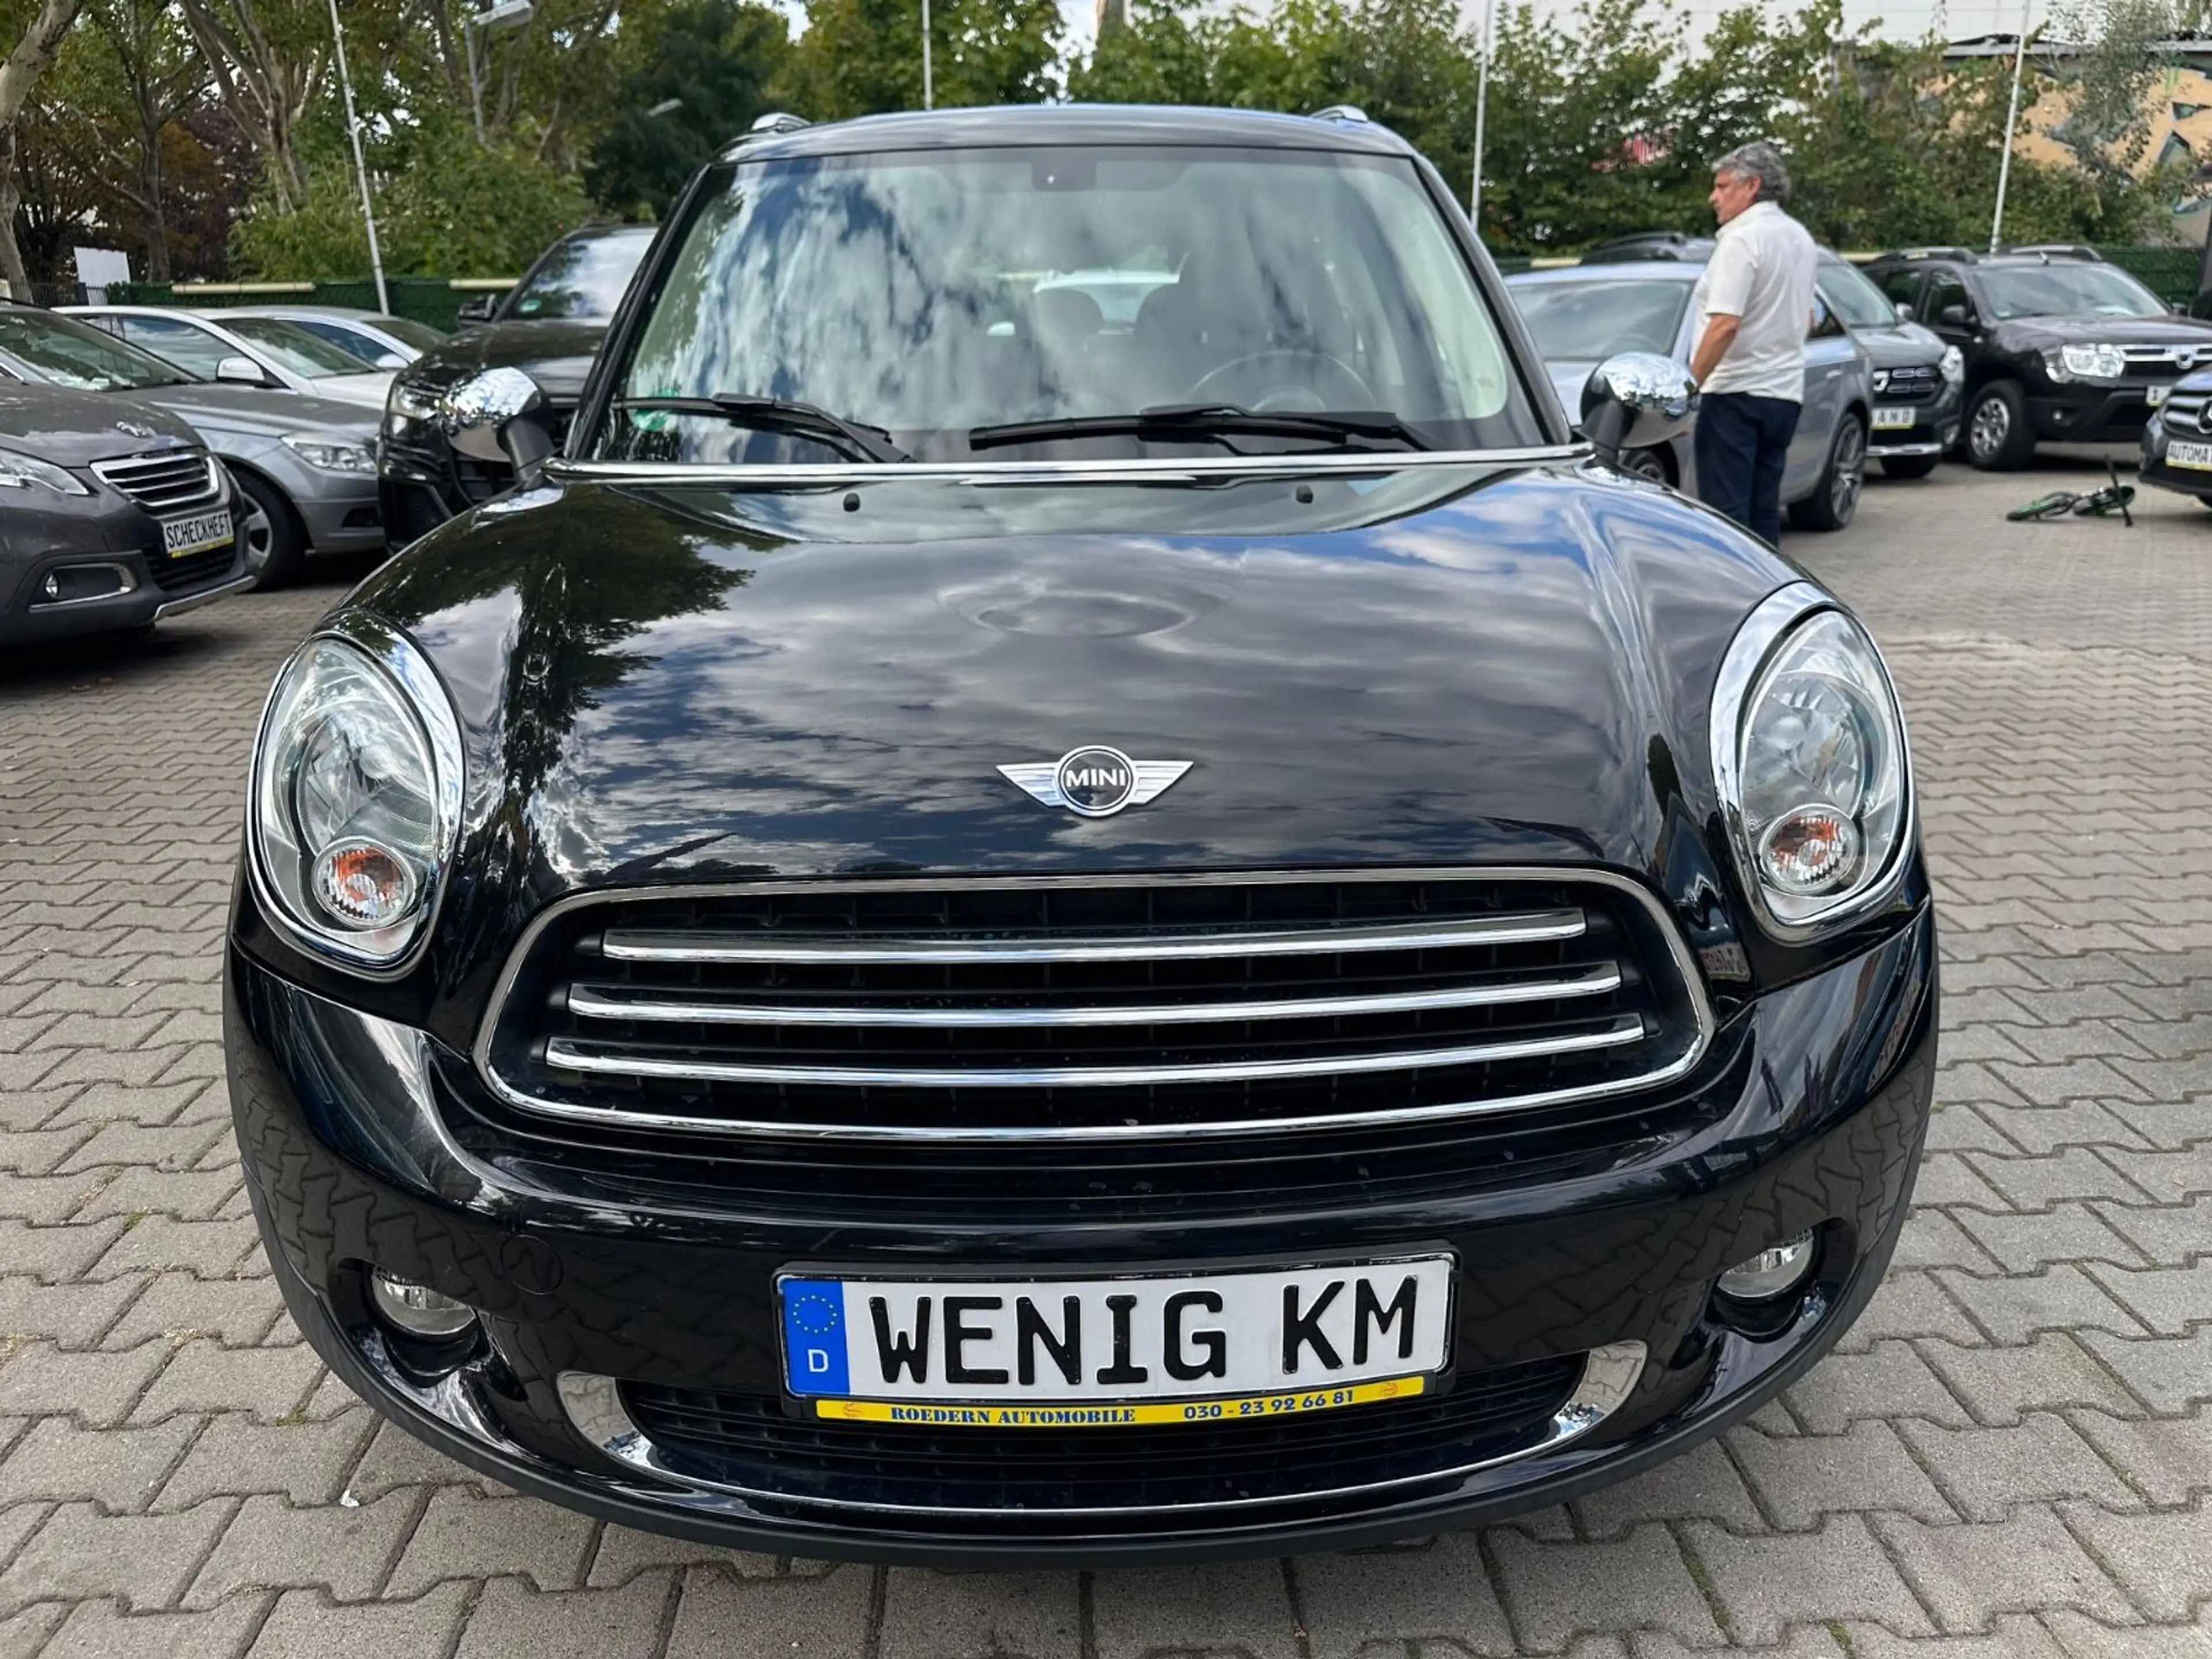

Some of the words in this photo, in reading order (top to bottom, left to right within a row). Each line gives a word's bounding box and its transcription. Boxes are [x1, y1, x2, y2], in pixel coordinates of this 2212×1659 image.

[166, 513, 231, 548] SCHECKHEFT
[1066, 768, 1126, 787] MINI
[869, 1290, 1227, 1386] WENIG
[1282, 1274, 1418, 1375] KM
[808, 1349, 829, 1373] D
[891, 1407, 990, 1423] ROEDERN
[998, 1408, 1136, 1425] AUTOMOBILE
[1184, 1404, 1222, 1420] 030
[1240, 1400, 1265, 1416] 23
[1271, 1398, 1296, 1412] 92
[1302, 1394, 1327, 1409] 66
[1332, 1389, 1354, 1404] 81
